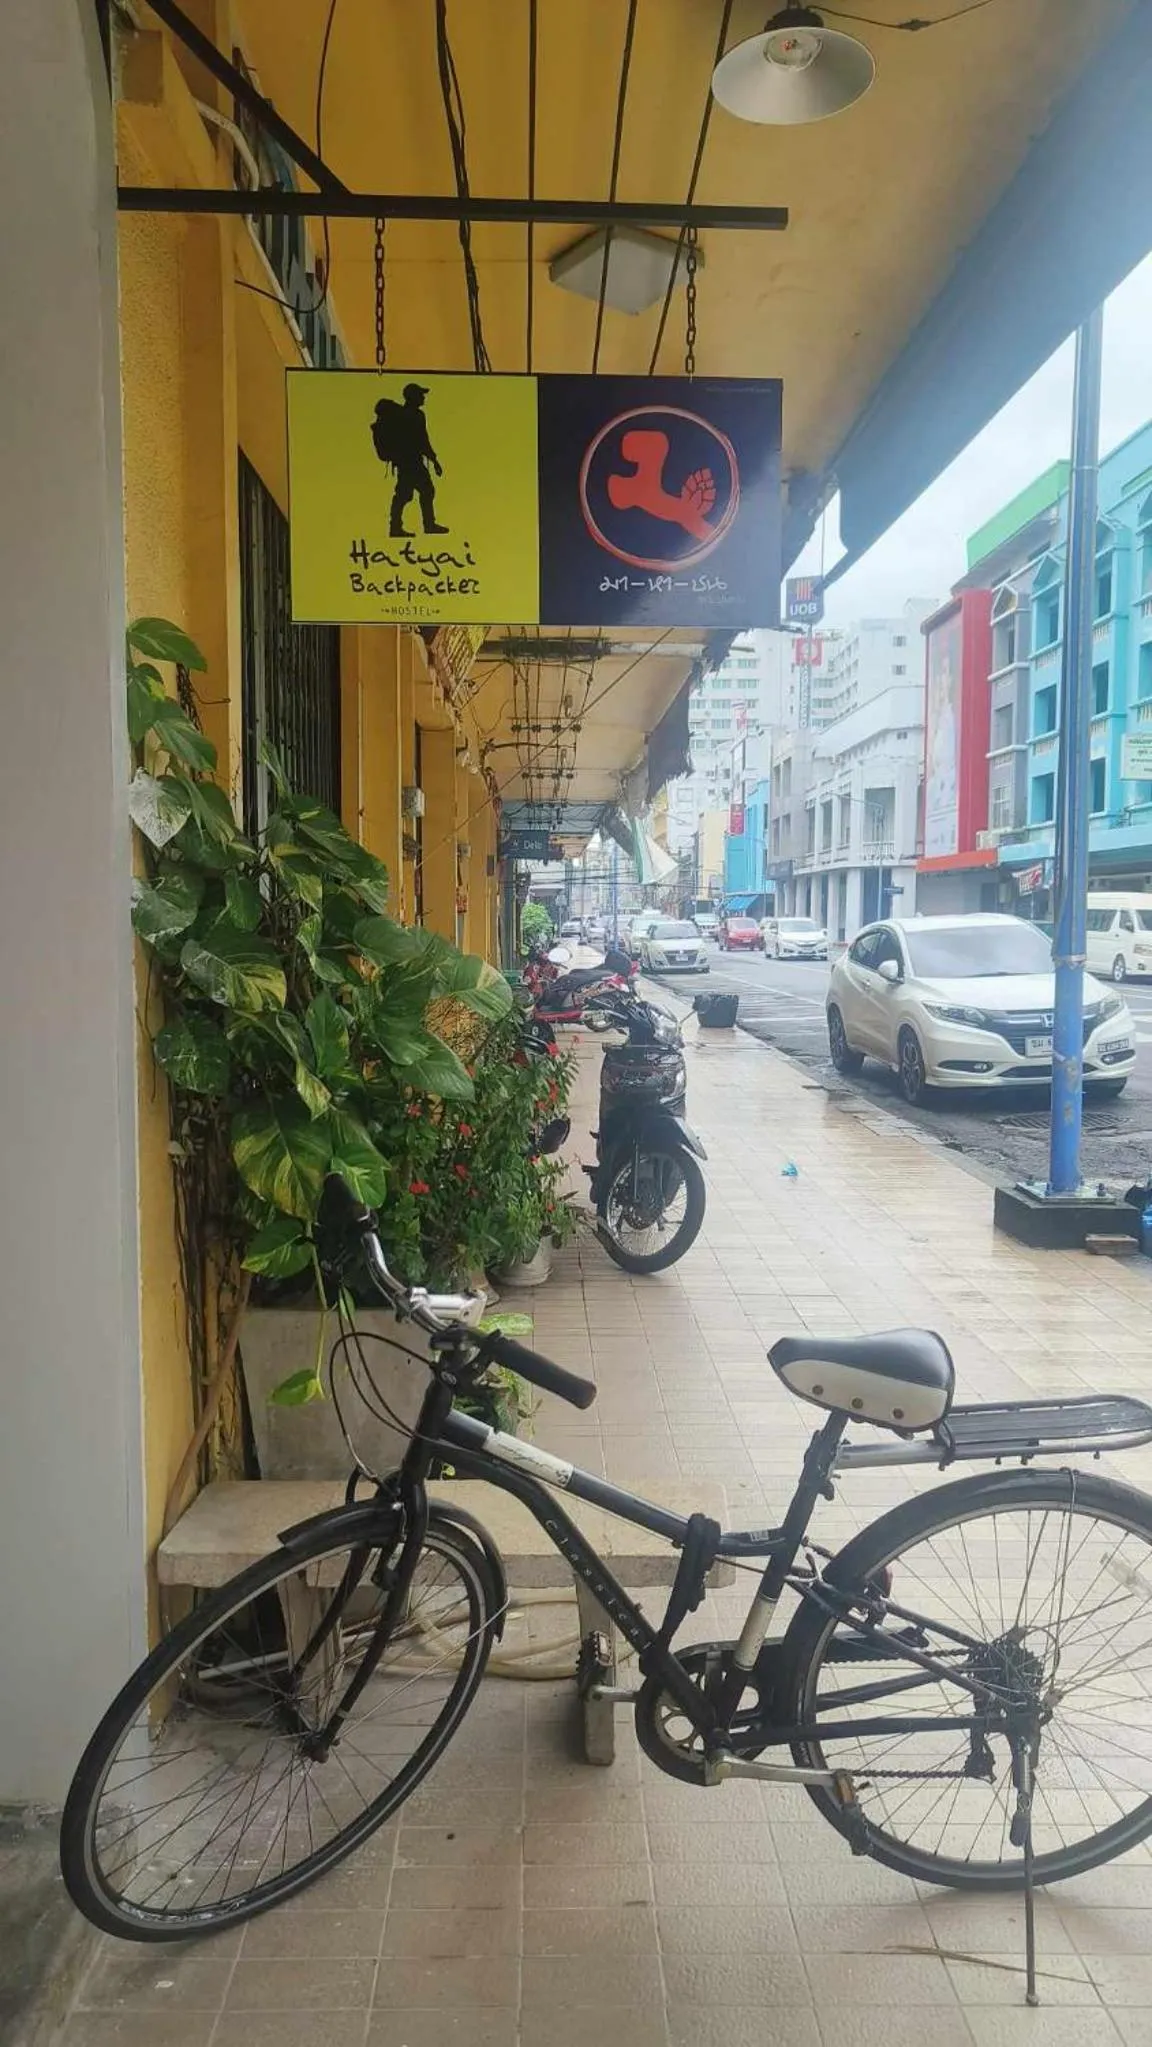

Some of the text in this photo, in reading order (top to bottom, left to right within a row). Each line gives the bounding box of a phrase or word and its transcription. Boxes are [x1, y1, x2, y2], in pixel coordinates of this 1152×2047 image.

[350, 539, 476, 577] Hatyai
[350, 573, 480, 602] Backpacker
[789, 602, 818, 616] UOB
